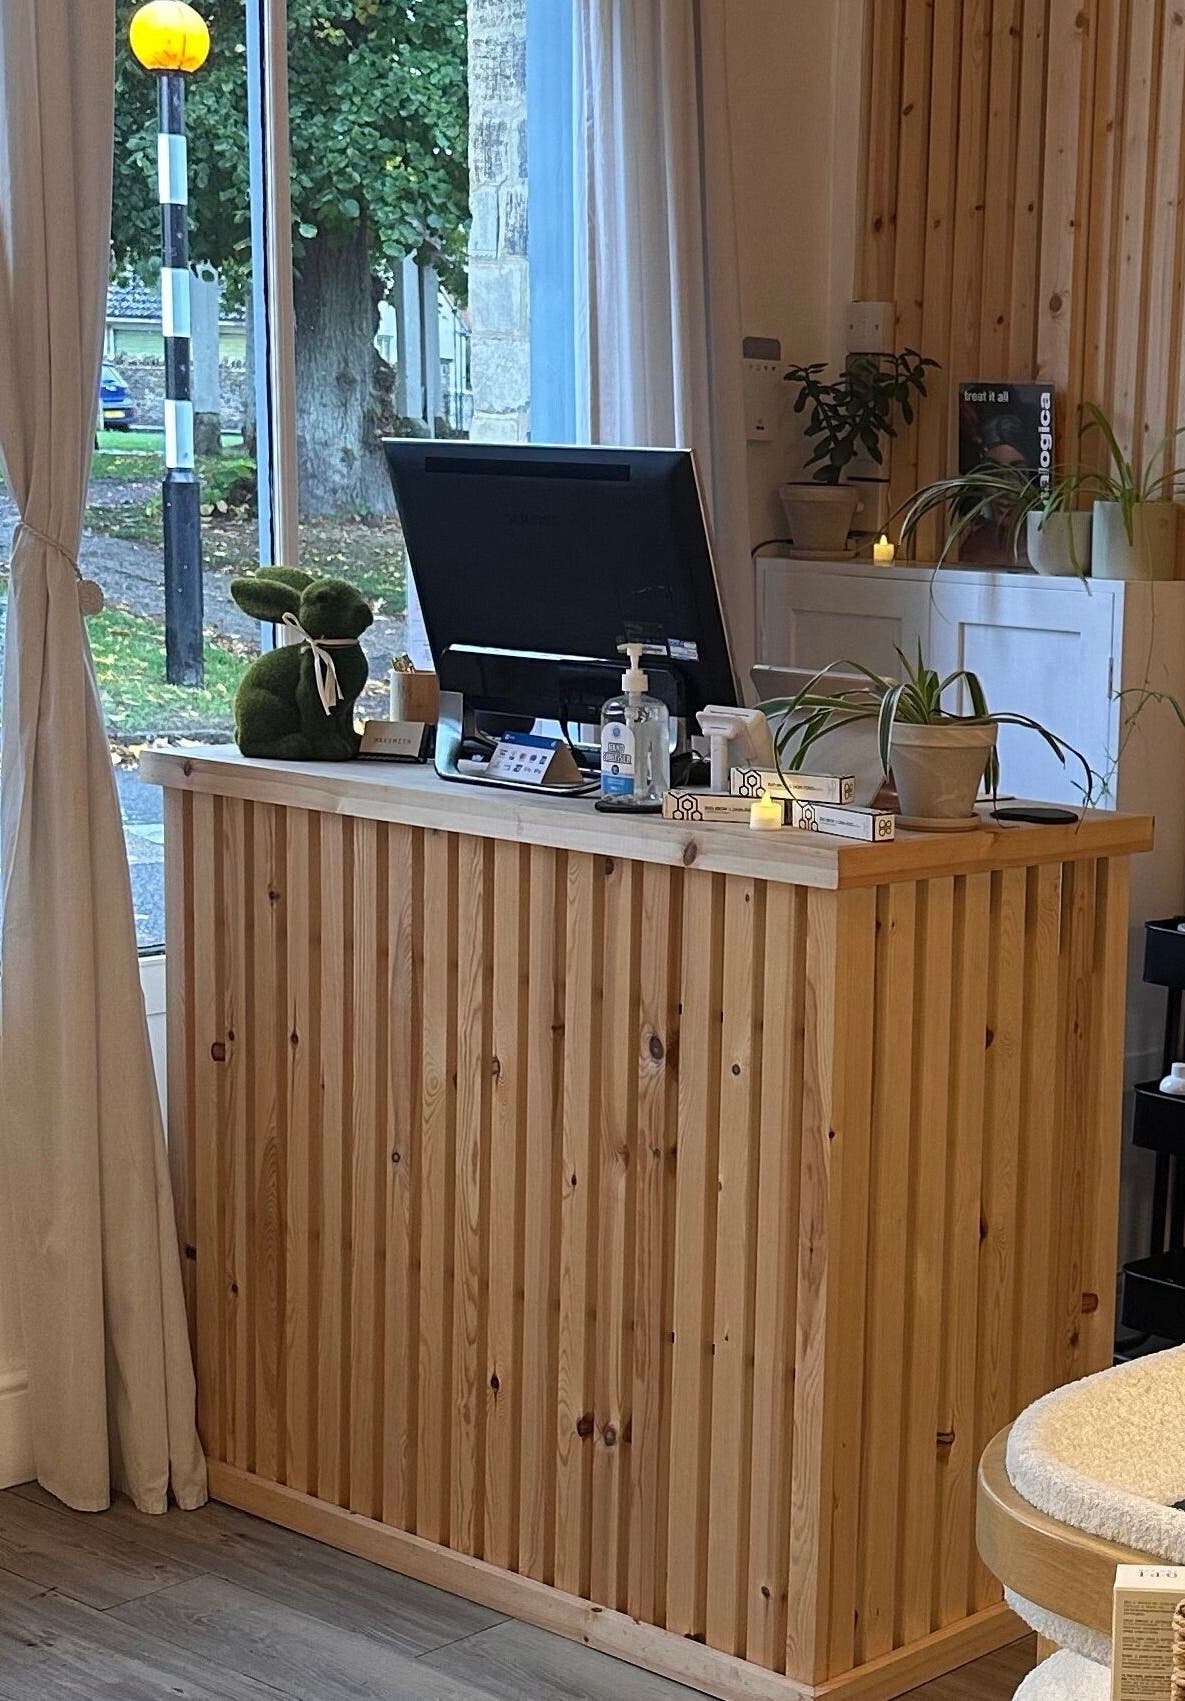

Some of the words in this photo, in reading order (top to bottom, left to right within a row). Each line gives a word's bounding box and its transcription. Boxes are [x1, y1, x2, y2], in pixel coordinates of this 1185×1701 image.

[964, 391, 987, 402] treat
[989, 391, 996, 402] it
[997, 391, 1009, 403] all
